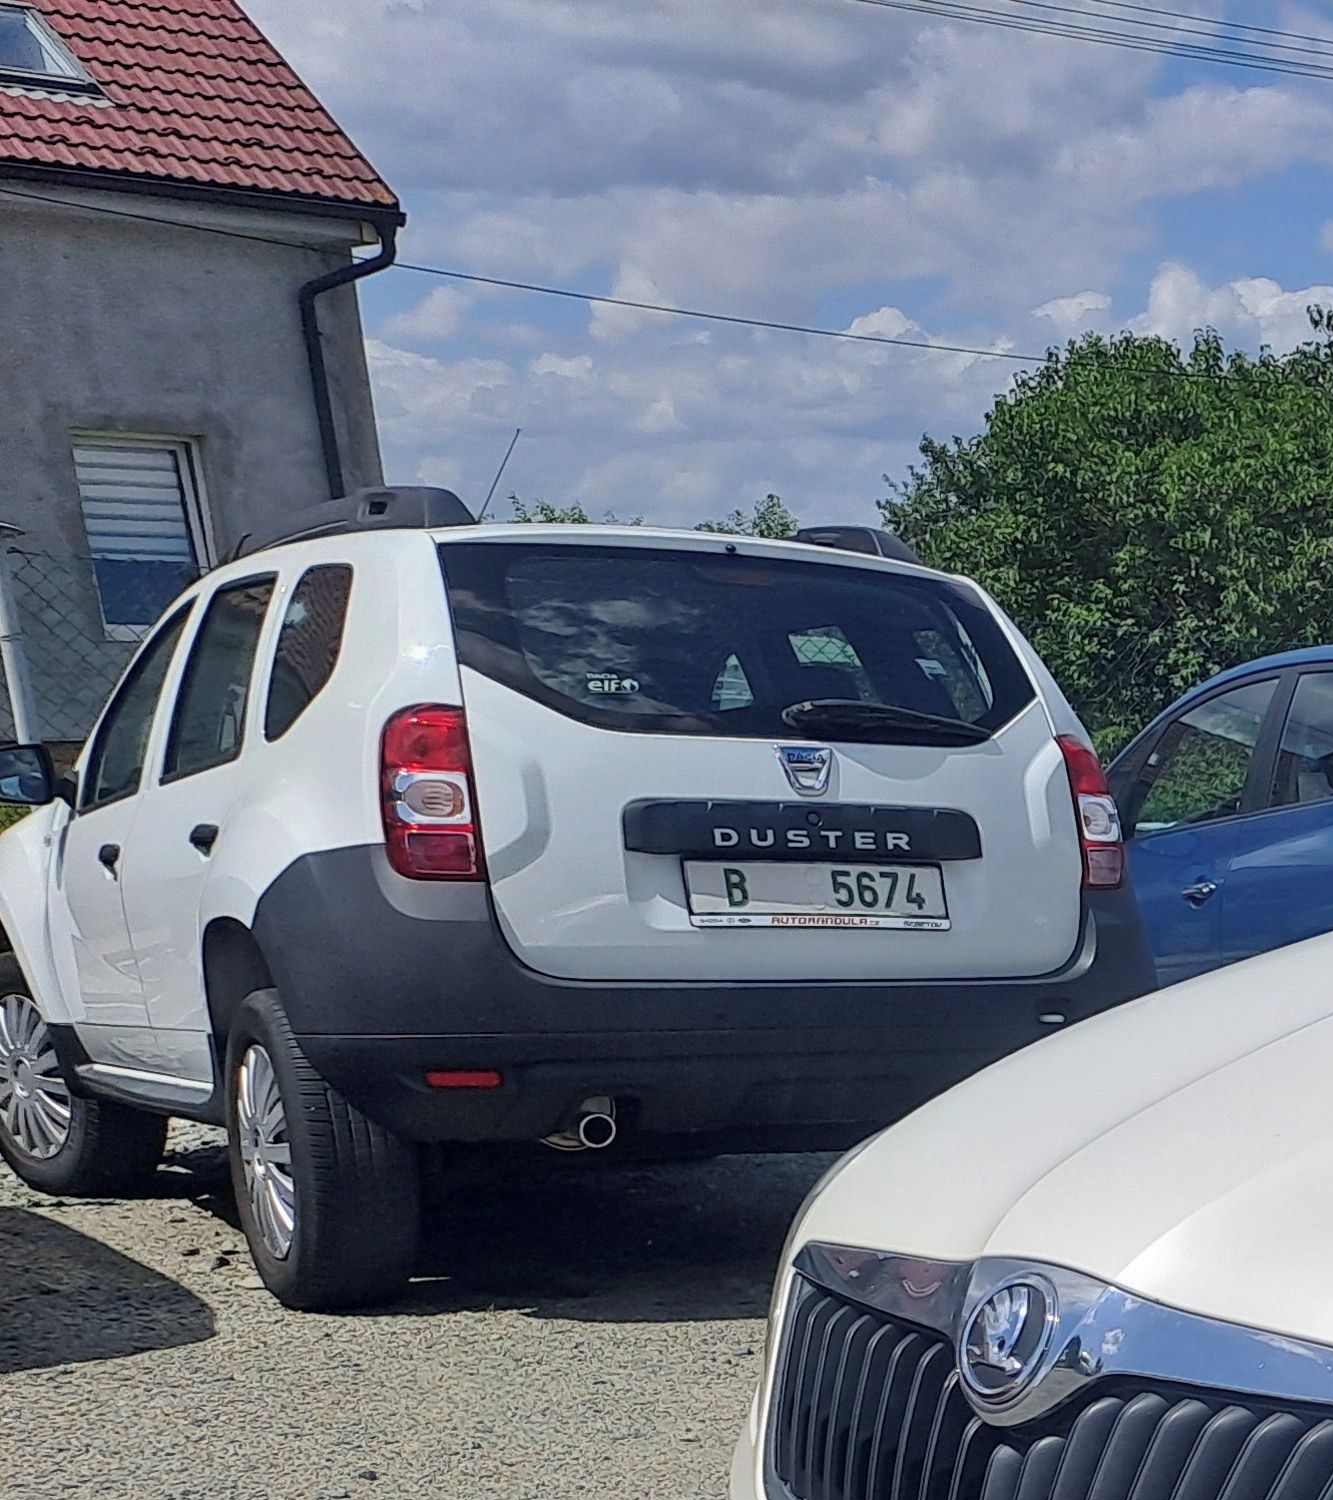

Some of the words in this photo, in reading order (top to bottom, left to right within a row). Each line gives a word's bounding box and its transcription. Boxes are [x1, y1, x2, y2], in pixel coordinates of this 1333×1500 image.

[712, 827, 911, 850] DUSTER
[723, 868, 749, 907] B
[831, 870, 926, 911] 5674
